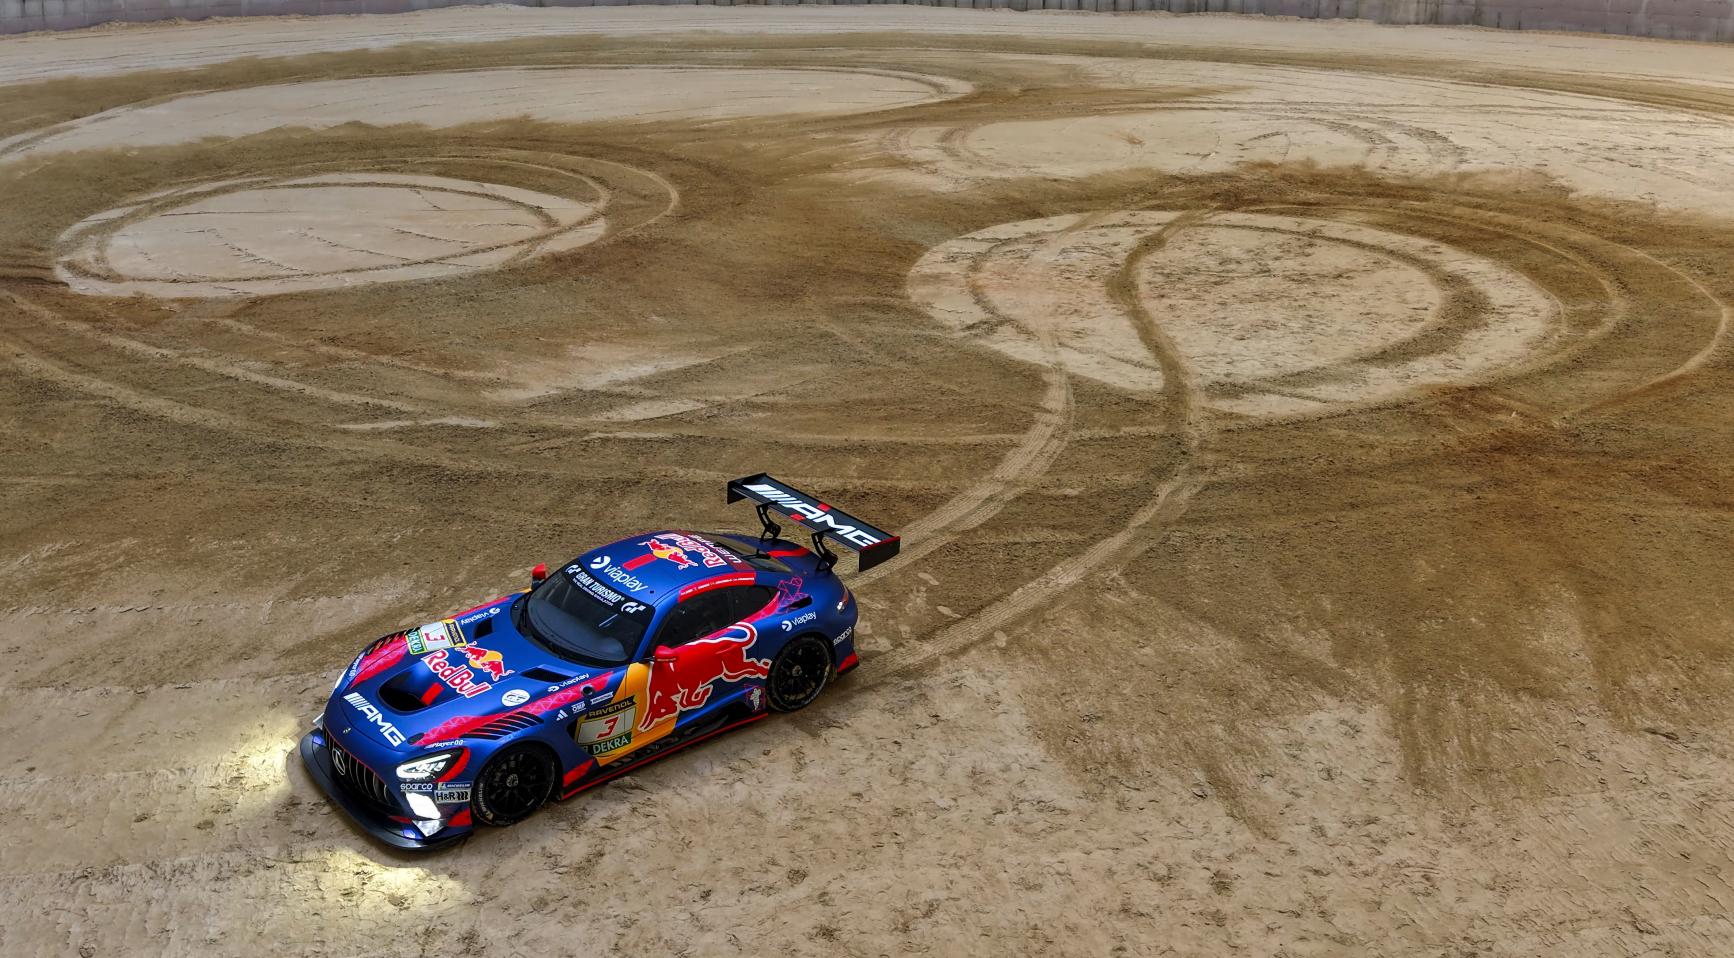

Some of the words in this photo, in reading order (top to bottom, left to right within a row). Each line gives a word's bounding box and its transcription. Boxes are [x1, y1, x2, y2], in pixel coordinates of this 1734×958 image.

[780, 500, 881, 547] AMG
[575, 572, 594, 586] GRAN
[589, 581, 621, 603] TURISMO
[603, 564, 648, 592] viaplay
[791, 611, 817, 627] viaplay
[424, 632, 446, 641] 3
[589, 700, 634, 718] RAVENOL
[357, 703, 407, 748] AMG
[597, 716, 618, 739] 3
[593, 735, 629, 755] DEKRA
[400, 783, 433, 791] sparco
[436, 791, 457, 801] H&R
